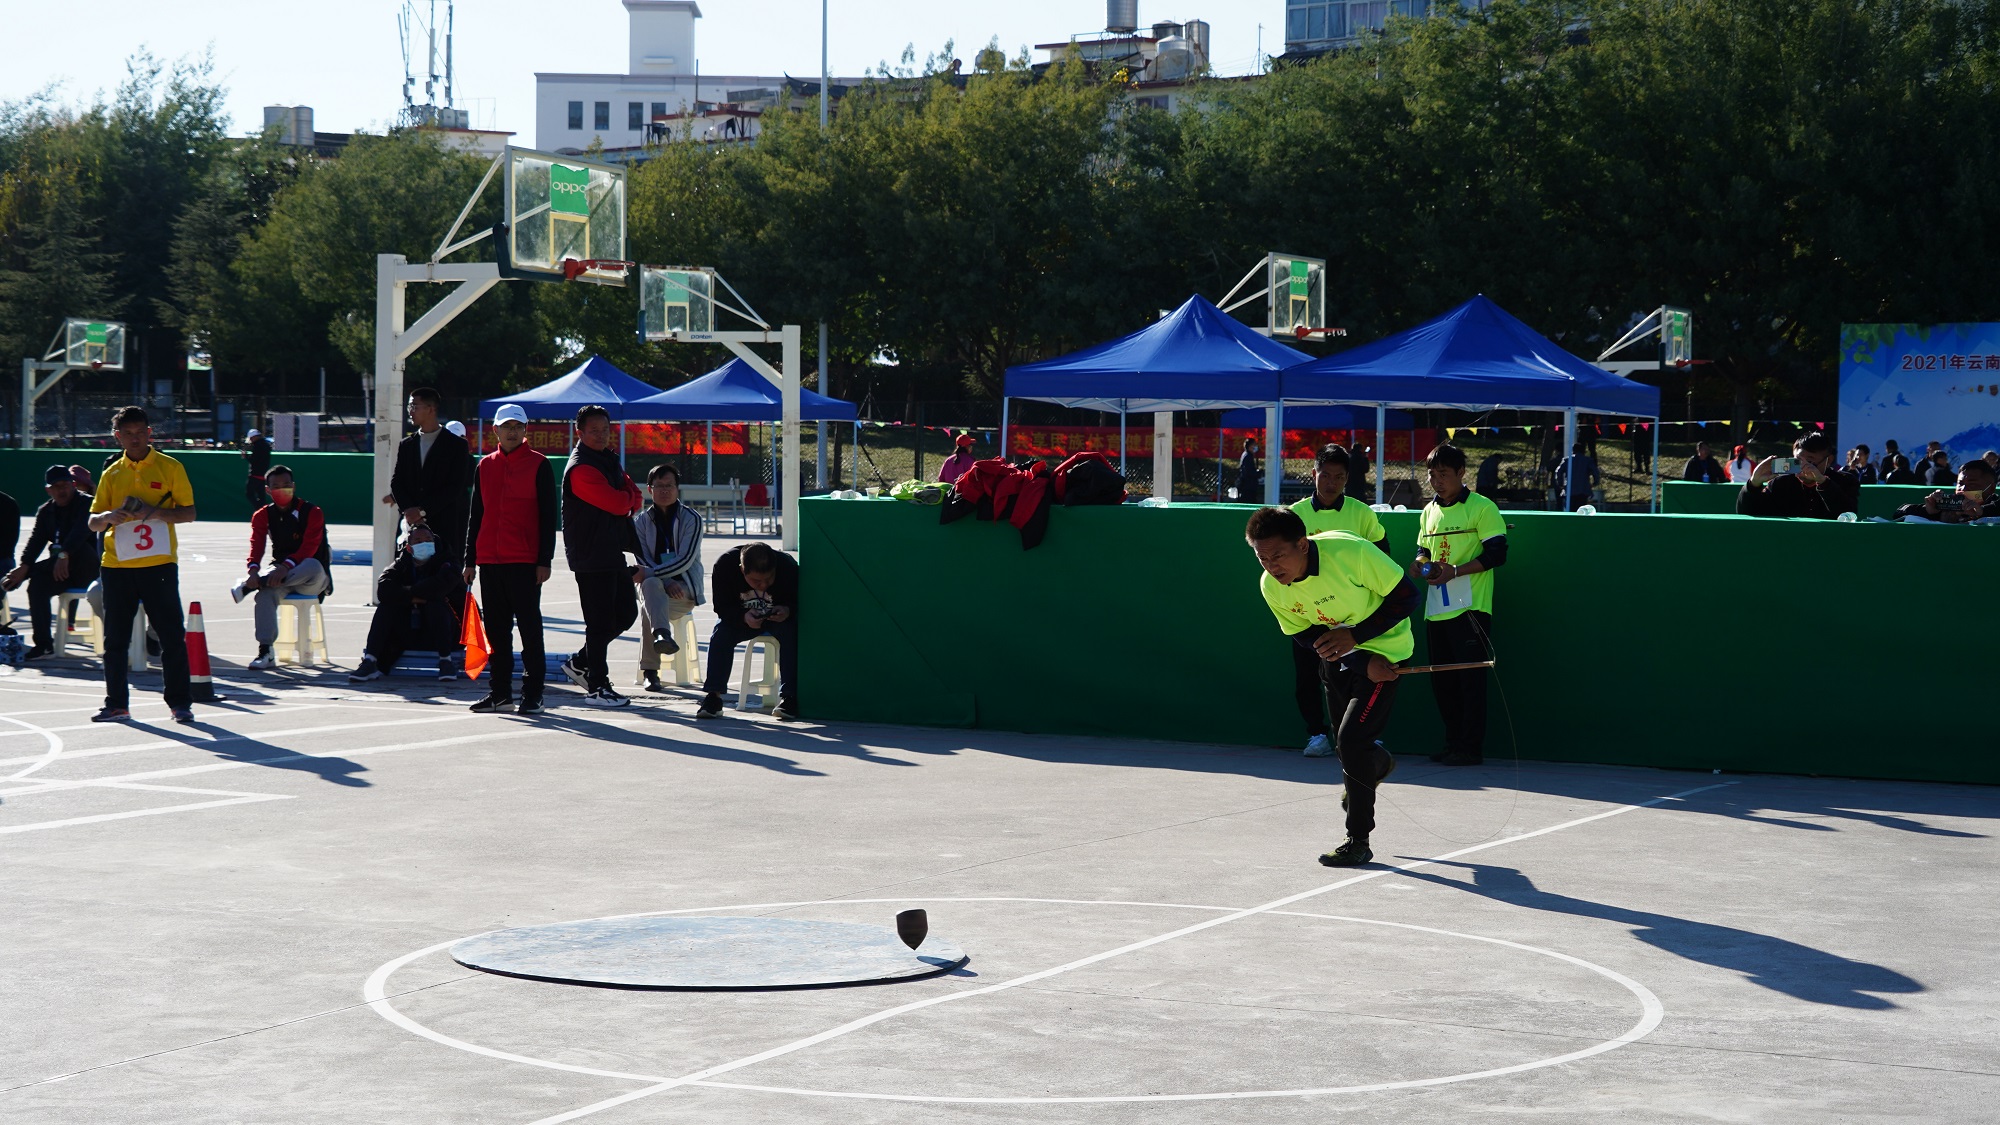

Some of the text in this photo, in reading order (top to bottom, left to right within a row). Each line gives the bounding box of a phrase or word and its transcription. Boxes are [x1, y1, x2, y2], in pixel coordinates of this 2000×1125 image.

[1902, 354, 2000, 371] 2021年云南
[133, 524, 154, 551] 3
